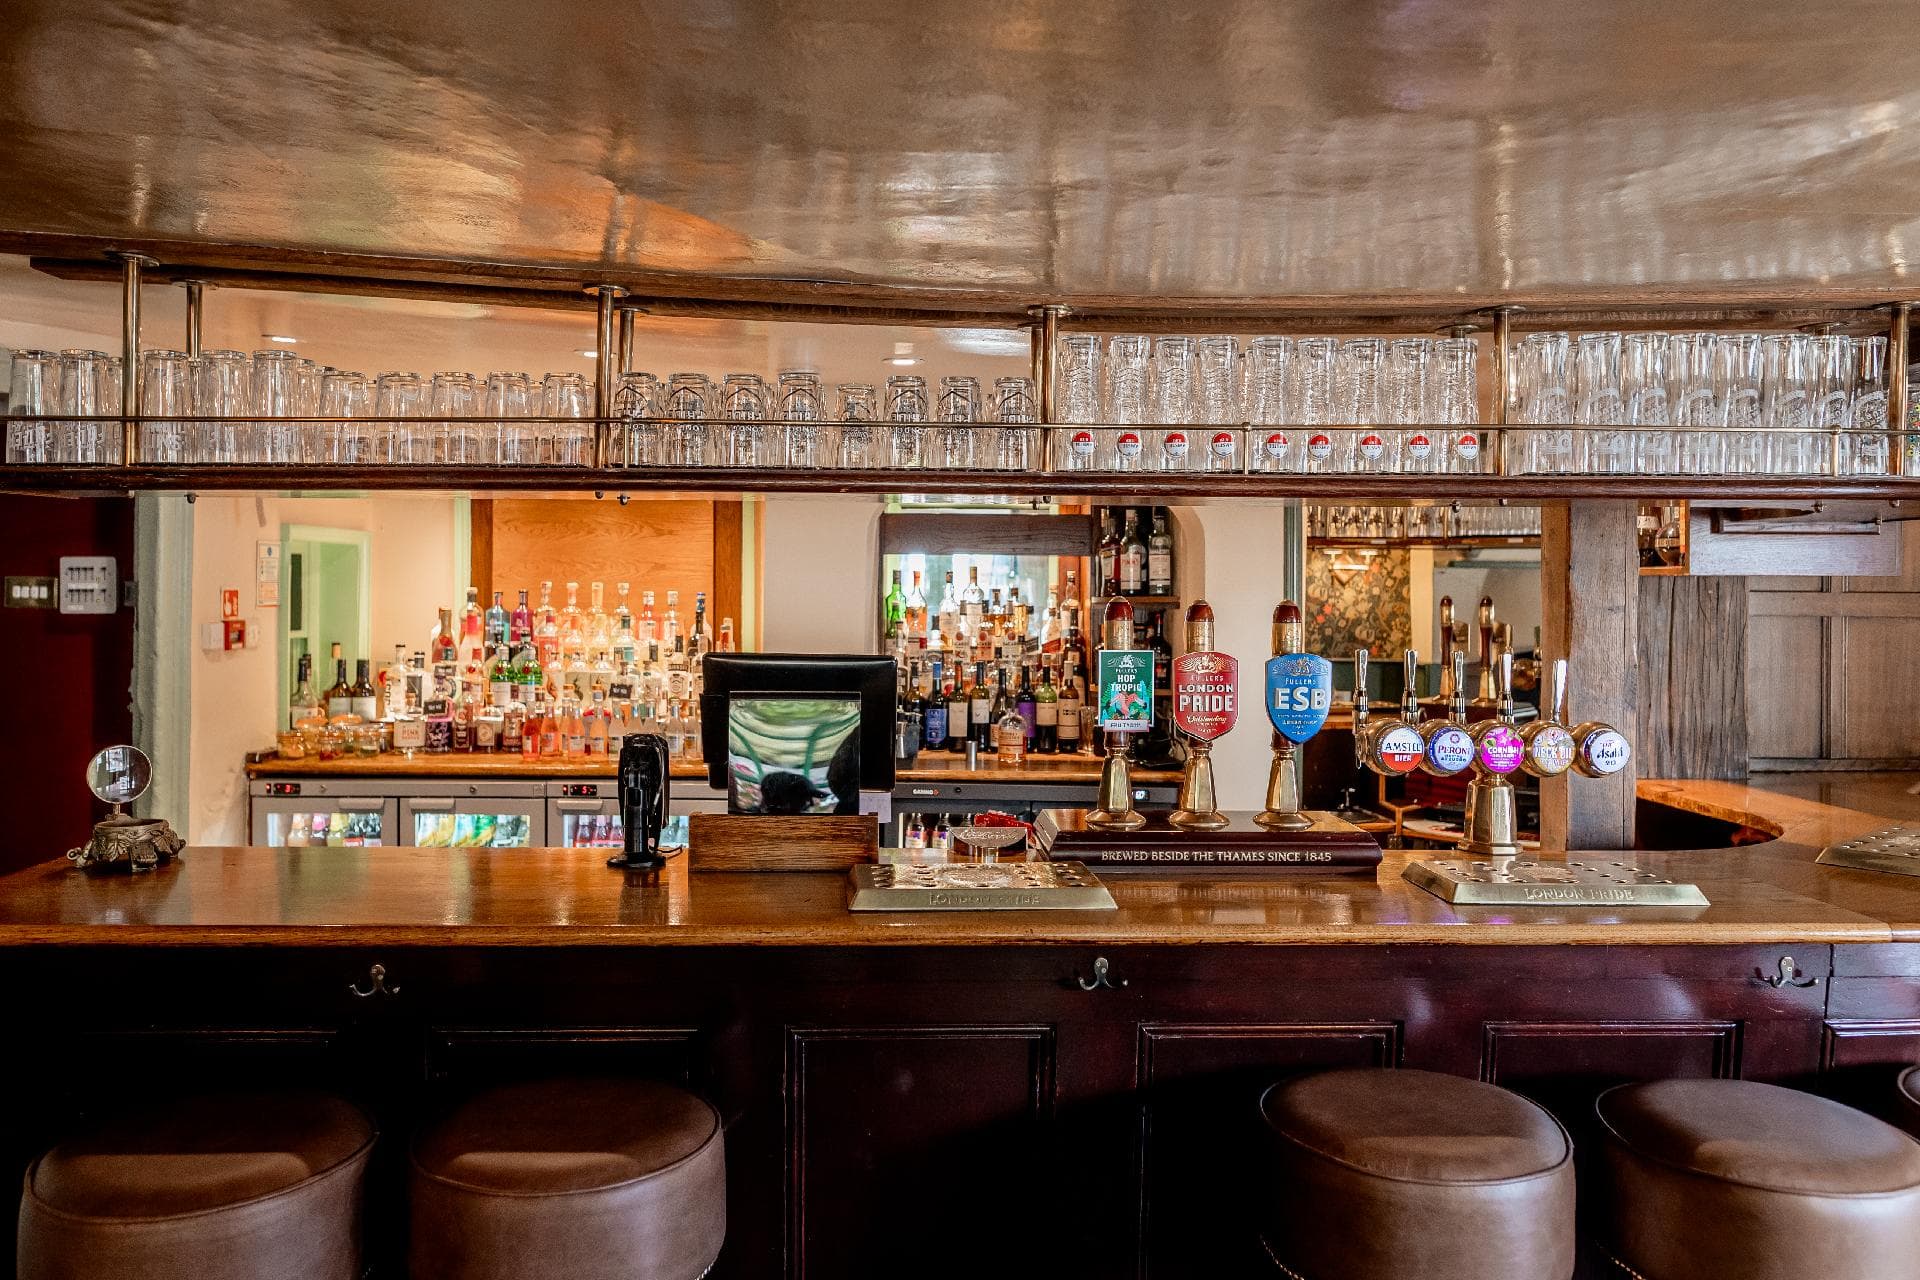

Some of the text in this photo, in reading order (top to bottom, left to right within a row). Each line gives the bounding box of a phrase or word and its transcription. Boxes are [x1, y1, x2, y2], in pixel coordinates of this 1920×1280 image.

[1117, 674, 1136, 683] HOP
[1111, 683, 1143, 692] TROPIC
[1178, 684, 1234, 693] LONDON
[1178, 694, 1234, 712] PRIDE
[1274, 686, 1327, 711] ESB
[1384, 742, 1421, 752] AMSTEL
[1438, 745, 1471, 755] PERONI
[1394, 754, 1413, 762] BIER
[1596, 746, 1624, 760] Asahi
[1101, 850, 1332, 862] BREWED BESIDE THE THAMES SINCE 1845
[1523, 888, 1635, 901] LONDON PRIDE
